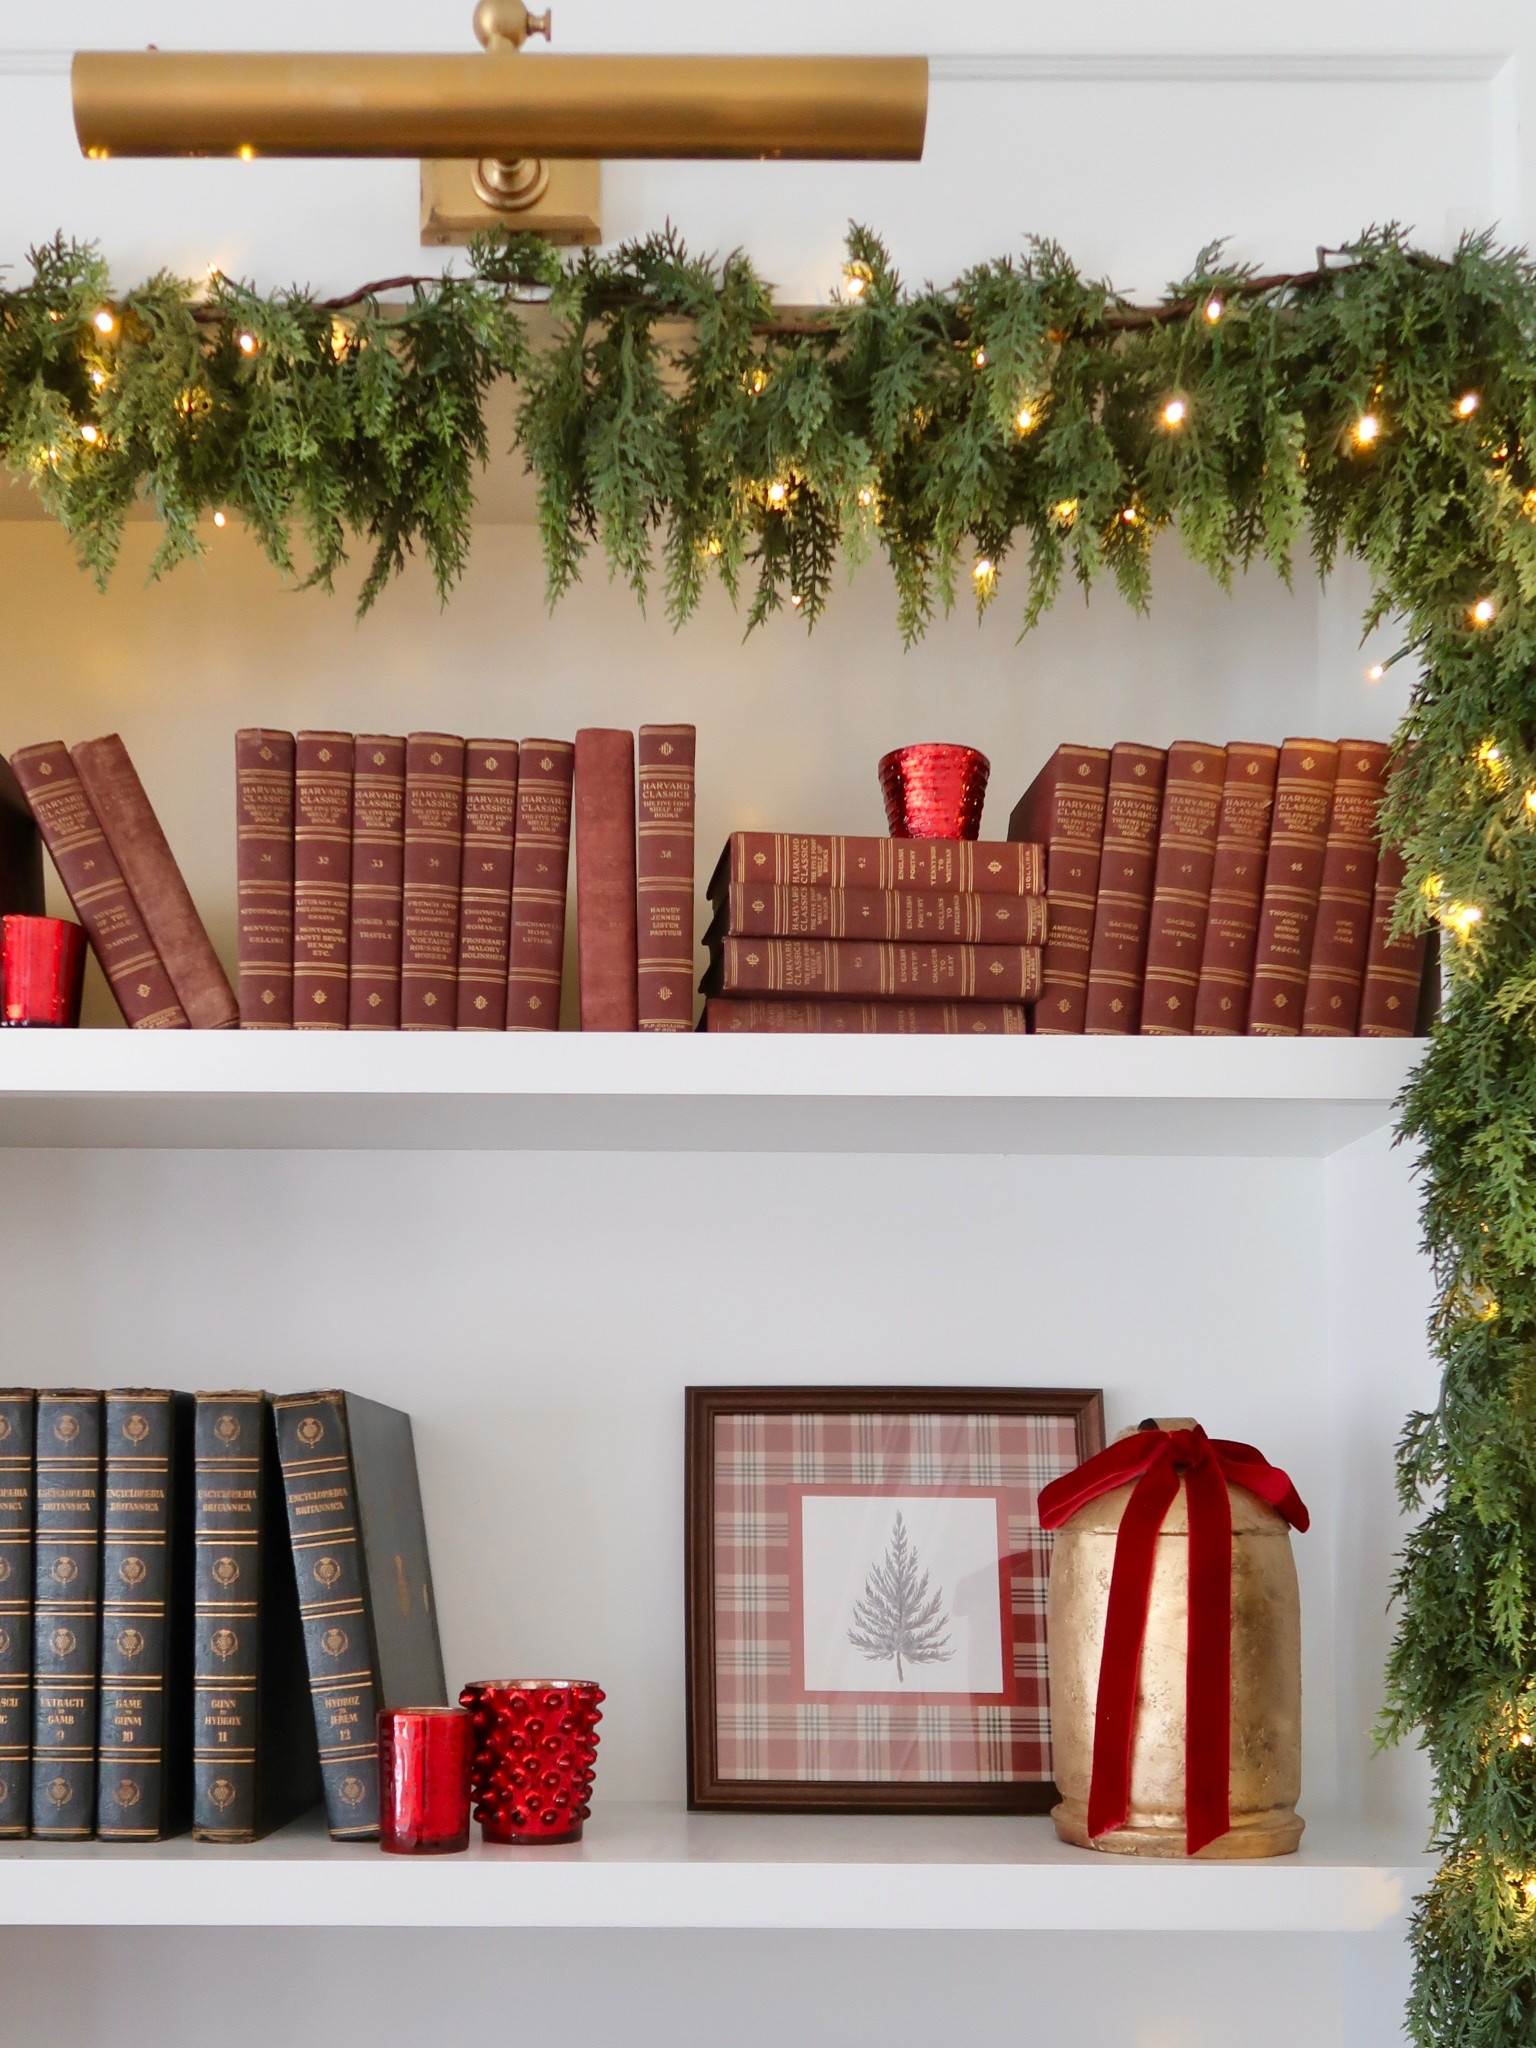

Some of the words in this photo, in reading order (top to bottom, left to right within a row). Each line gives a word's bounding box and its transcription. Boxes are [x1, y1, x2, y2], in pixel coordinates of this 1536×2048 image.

[243, 787, 290, 796] HARVARD
[300, 787, 347, 796] HARVARD
[643, 782, 690, 790] HARVARD
[300, 796, 347, 805] CLASSICS
[355, 791, 402, 800] HARVARD
[412, 791, 459, 800] HARVARD
[467, 795, 513, 804] HARVARD
[522, 795, 567, 805] HARVARD
[643, 791, 689, 799] CLASSICS
[1280, 794, 1327, 807] HARVARD
[355, 799, 402, 809] CLASSICS
[411, 799, 458, 809] CLASSICS
[466, 803, 512, 813] CLASSICS
[1058, 799, 1103, 812] HARVARD
[1113, 799, 1158, 812] HARVARD
[1170, 796, 1218, 810] HARVARD
[521, 804, 567, 814] CLASSICS
[1057, 808, 1102, 820] CLASSICS
[1112, 808, 1157, 820] CLASSICS
[1169, 805, 1216, 818] CLASSICS
[1278, 803, 1326, 815] CLASSICS
[661, 850, 672, 858] 38
[801, 839, 809, 884] CLASSICS
[858, 857, 866, 869] 42
[938, 858, 945, 870] TO
[1070, 869, 1081, 877] 43
[792, 886, 800, 931] HARVARD
[800, 887, 808, 932] CLASSICS
[862, 906, 869, 917] 41
[946, 907, 953, 919] TO
[1270, 944, 1300, 955] PASCAL
[785, 941, 793, 985] HARVARD
[794, 942, 803, 985] CLASSICS
[900, 948, 908, 983] ENGLISH
[911, 950, 919, 981] POETRY
[940, 959, 947, 972] TO
[43, 1502, 91, 1511] BRITANNICA
[111, 1502, 159, 1511] BRITANNICA
[203, 1503, 252, 1512] BRITANNICA
[295, 1502, 345, 1515] BRITANNICA
[115, 1699, 142, 1709] GAME
[211, 1699, 237, 1709] GUNN
[325, 1696, 360, 1709] HYDROZ
[48, 1715, 74, 1725] GAMB
[205, 1715, 241, 1726] HYDROX
[330, 1713, 359, 1726] JEREM
[57, 1730, 64, 1741] 9
[122, 1731, 133, 1742] 10
[218, 1731, 228, 1742] 11
[339, 1728, 351, 1741] 12
